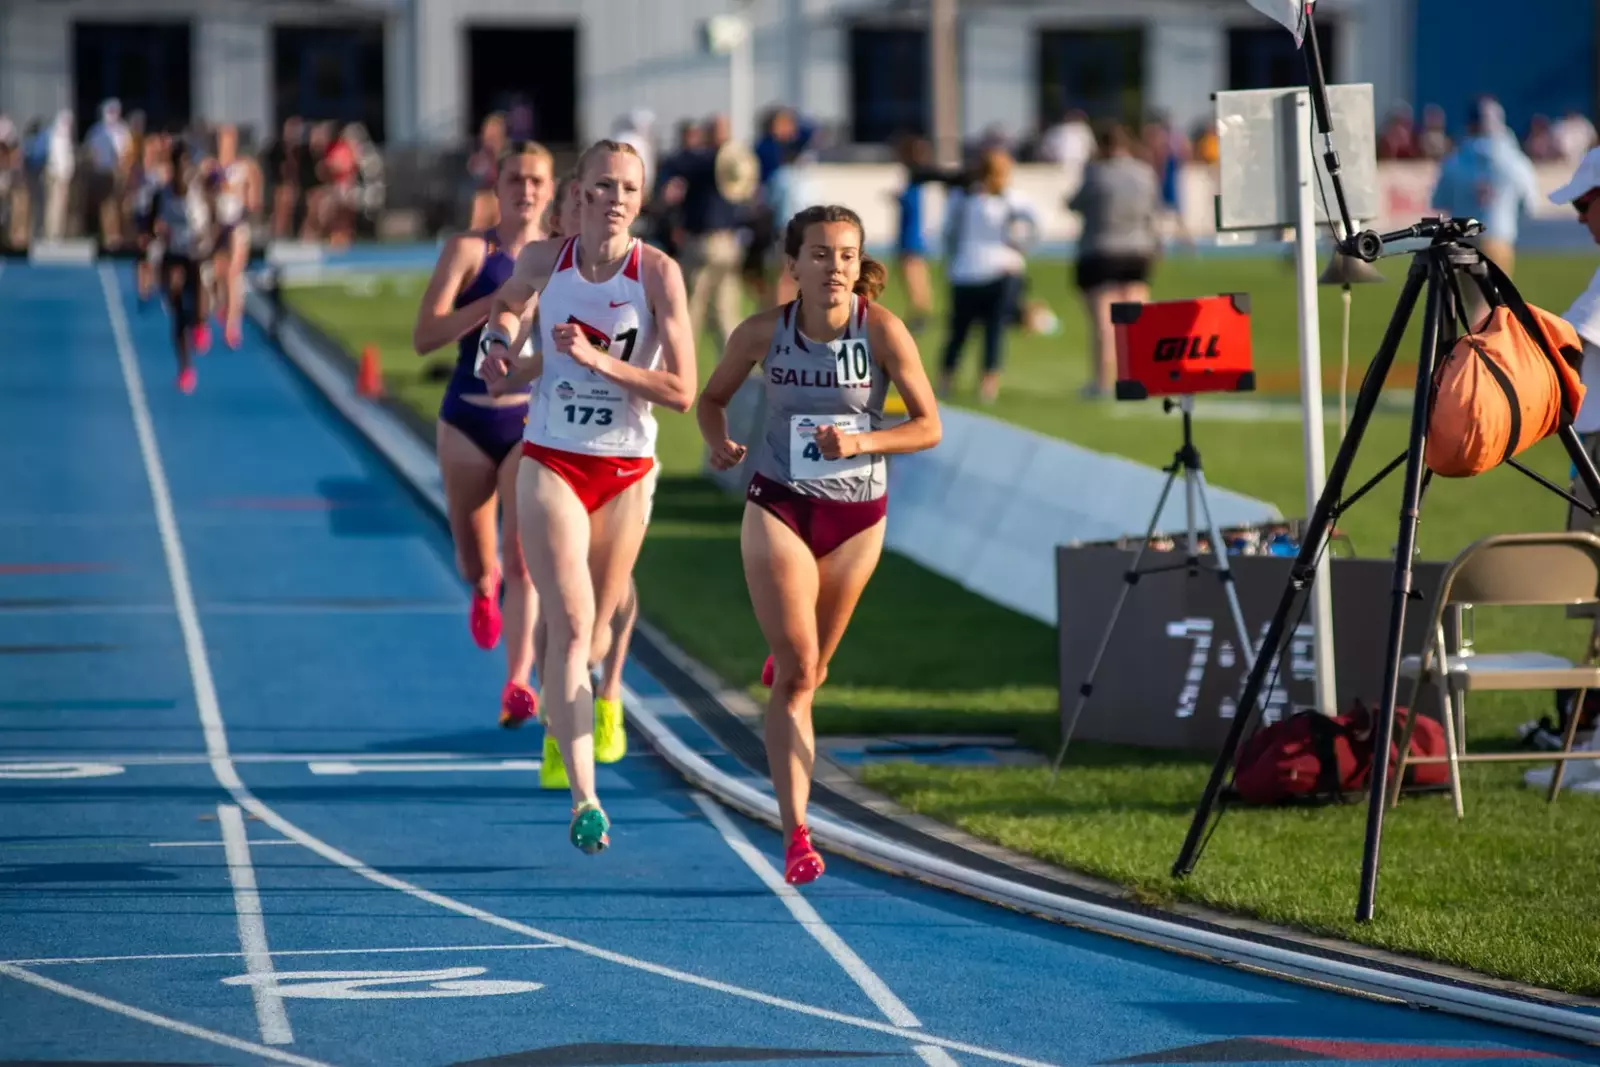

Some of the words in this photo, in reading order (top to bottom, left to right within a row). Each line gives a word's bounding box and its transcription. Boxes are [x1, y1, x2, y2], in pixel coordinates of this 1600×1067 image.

[615, 328, 638, 362] 1
[1153, 335, 1220, 362] GILL
[838, 342, 867, 381] 10
[771, 367, 872, 388] SALU
[564, 404, 613, 426] 173
